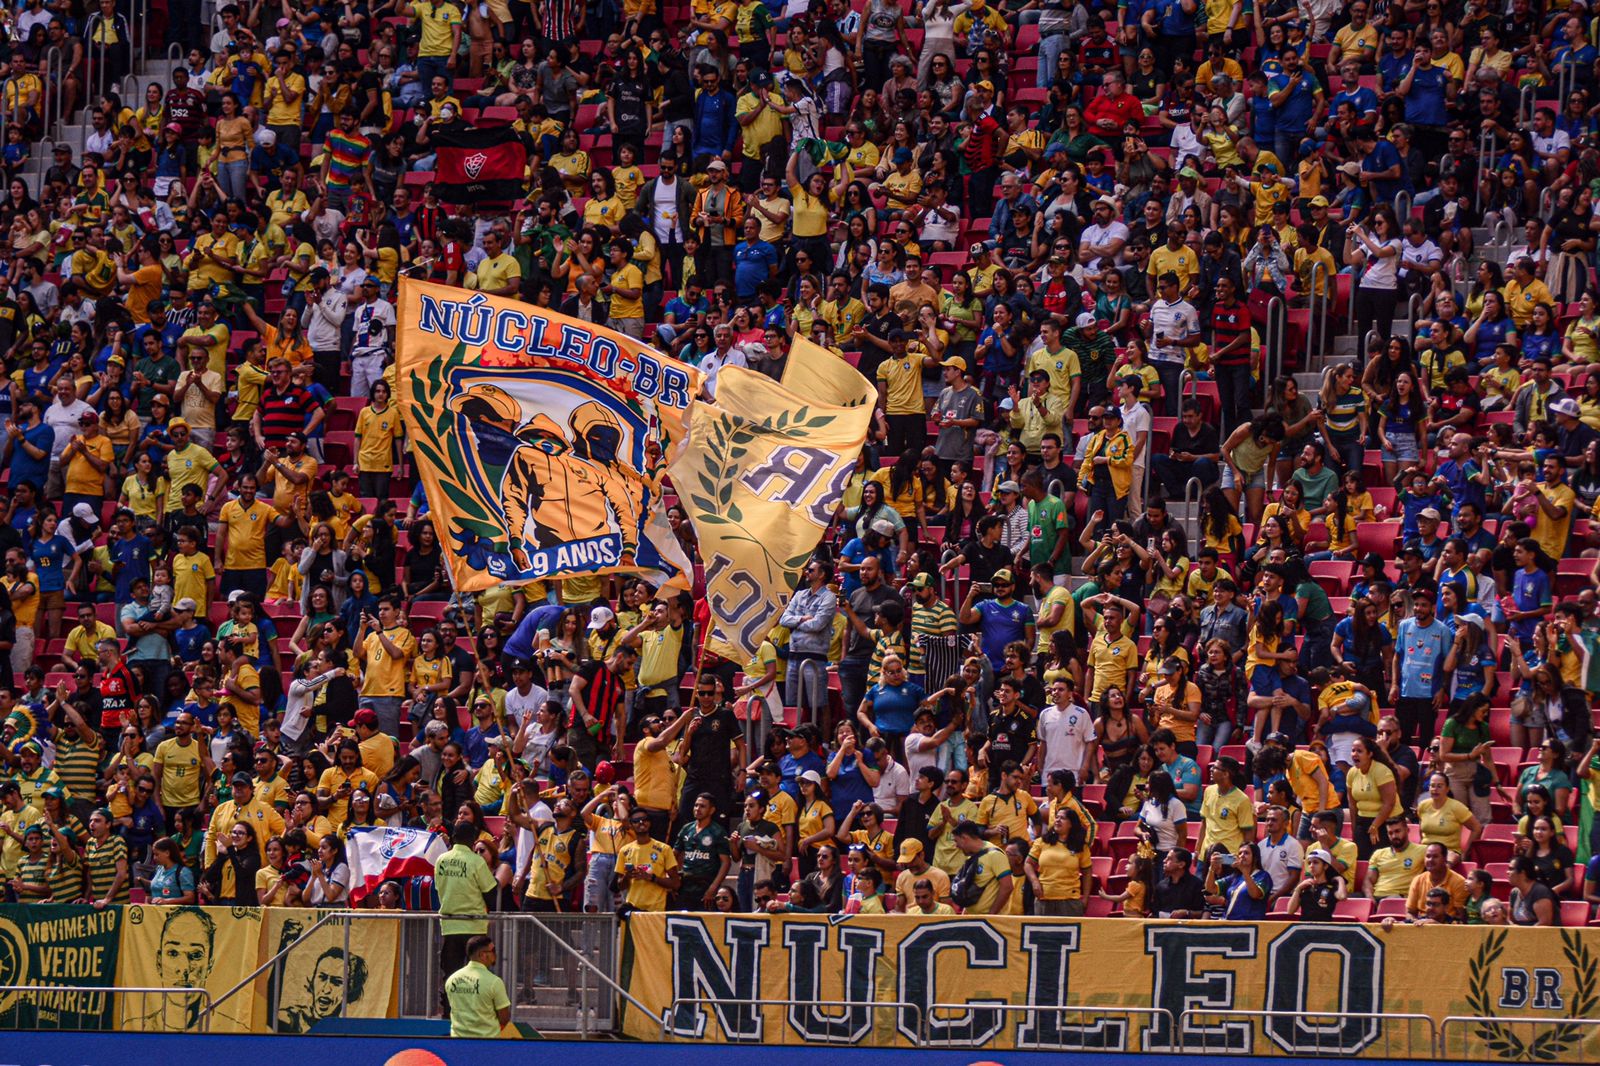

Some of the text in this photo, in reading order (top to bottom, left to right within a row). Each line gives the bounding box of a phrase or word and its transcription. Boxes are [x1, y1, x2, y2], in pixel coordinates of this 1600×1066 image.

[419, 293, 691, 409] NÚCLEO-BR
[556, 537, 616, 569] ANOS
[374, 648, 383, 661] 8
[27, 909, 116, 945] MOVIMENTO
[39, 946, 105, 978] VERDE
[1496, 966, 1565, 1009] BR
